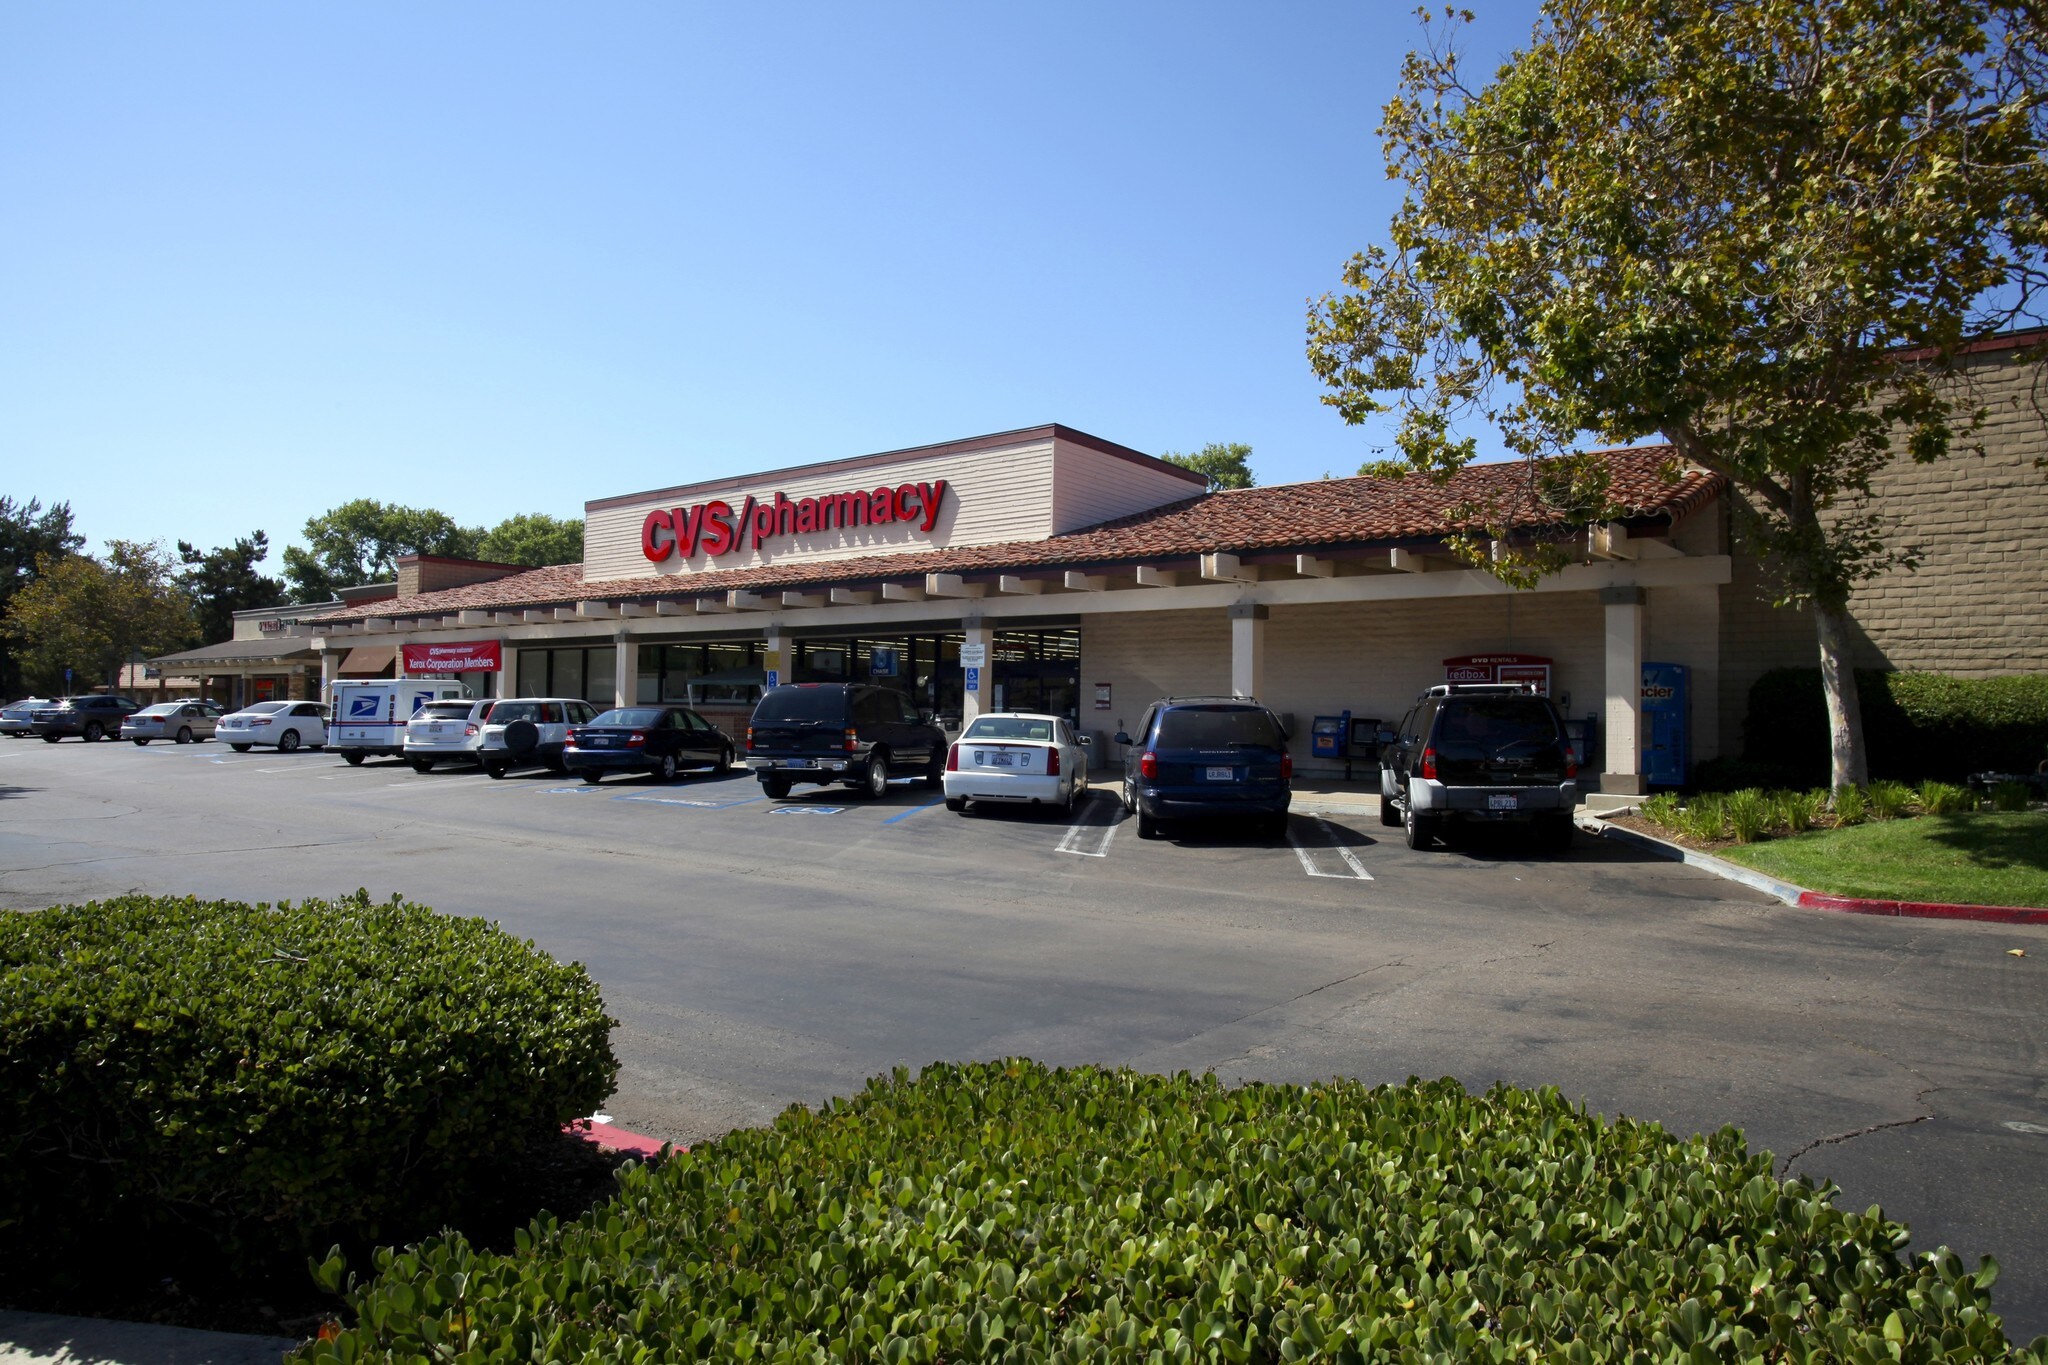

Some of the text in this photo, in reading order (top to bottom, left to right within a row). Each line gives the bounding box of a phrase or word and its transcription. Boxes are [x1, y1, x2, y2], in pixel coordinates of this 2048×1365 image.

[641, 479, 948, 563] CVS/pharmacy
[409, 656, 494, 671] Xerox Corporation Members
[1449, 669, 1486, 679] redbox
